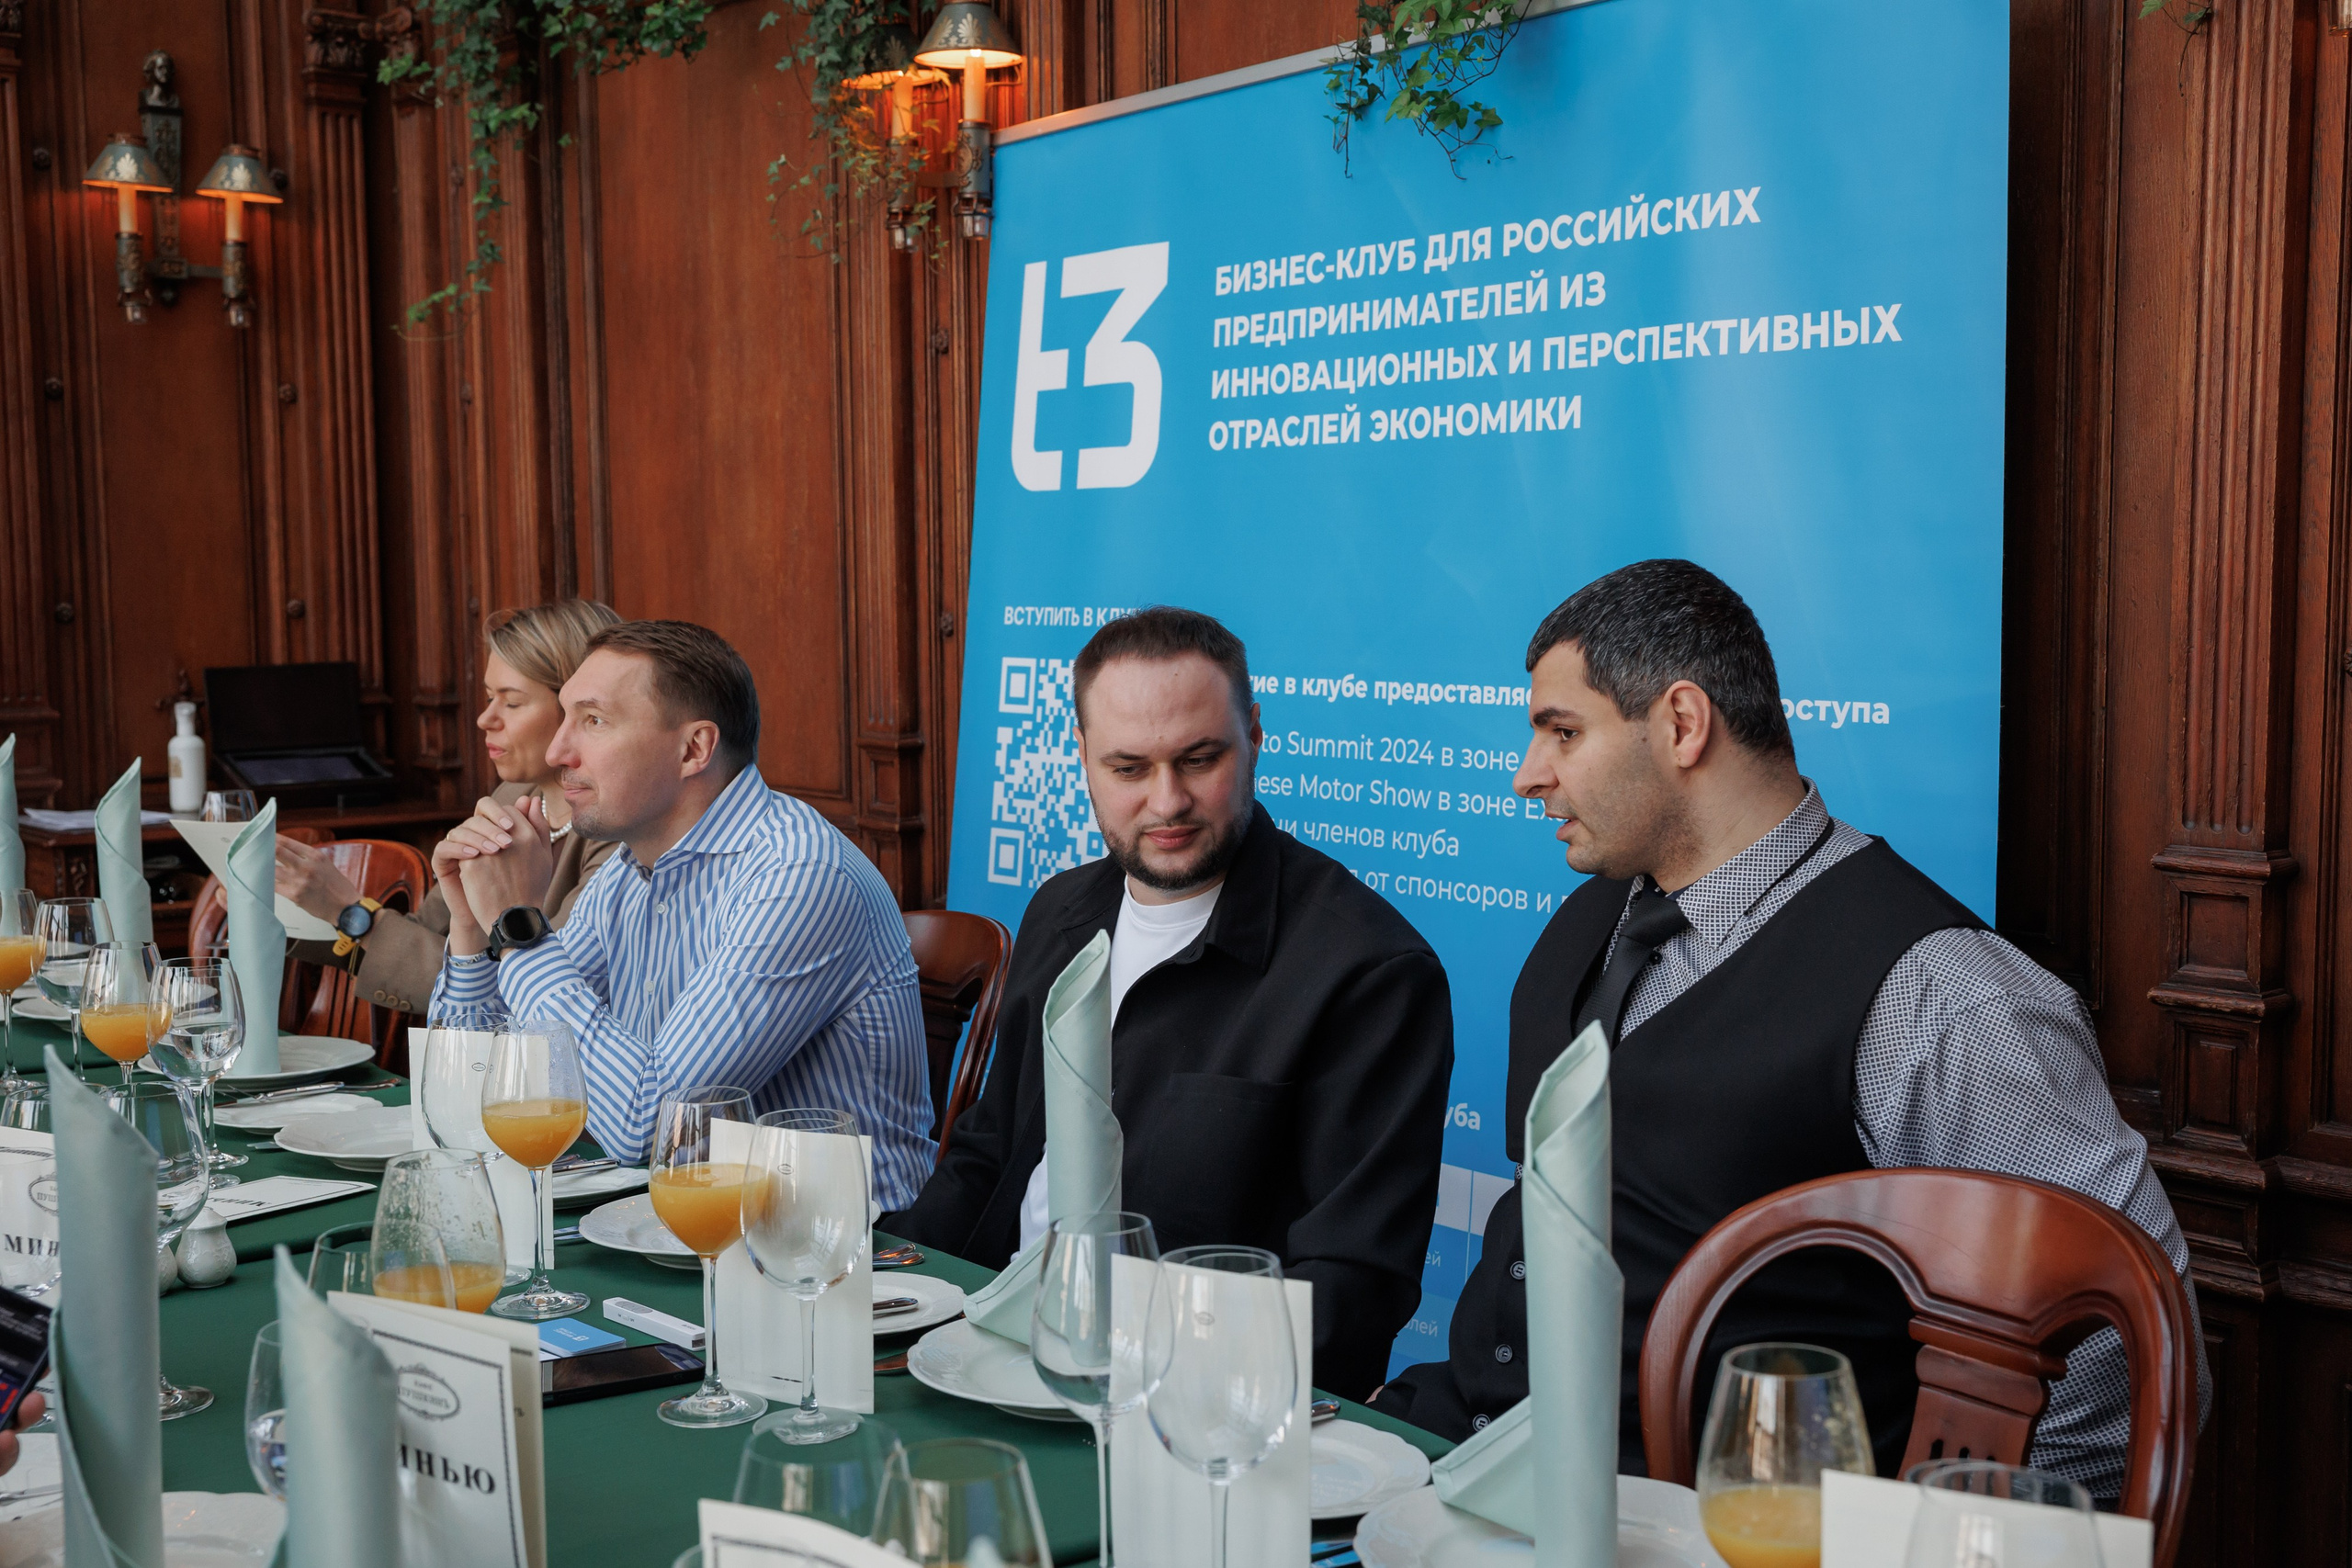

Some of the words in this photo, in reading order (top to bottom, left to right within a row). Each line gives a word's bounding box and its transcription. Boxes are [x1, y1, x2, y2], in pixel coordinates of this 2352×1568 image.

[1216, 238, 1417, 296] БИЗНЕС-КЛУБ
[1424, 226, 1492, 275] ДЛЯ
[1502, 186, 1761, 257] РОССИЙСКИХ
[1214, 269, 1548, 349] ПРЕДПРИНИМАТЕЛЕЙ
[1561, 272, 1606, 310] ИЗ
[1211, 344, 1498, 400] ИННОВАЦИОННЫХ
[1509, 340, 1532, 375] И
[1543, 303, 1905, 371] ПЕРСПЕКТИВНЫХ
[1208, 403, 1361, 451] ОТРАСЛЕЙ
[1369, 395, 1582, 442] ЭКОНОМИКИ
[1003, 605, 1080, 626] ВСТУПИТЬ
[1083, 606, 1093, 626] В
[1284, 676, 1296, 694] в
[1302, 673, 1368, 703] клубе
[1781, 698, 1890, 729] оступа
[1287, 730, 1374, 761] Summit
[1380, 737, 1435, 766] 2024
[1441, 747, 1454, 768] в
[1459, 748, 1520, 773] зоне
[1300, 773, 1364, 804] Motor
[1369, 779, 1431, 810] Show
[1438, 791, 1451, 812] в
[1457, 793, 1517, 818] зоне
[1304, 821, 1385, 848] членов
[1392, 829, 1460, 859] клуба
[1365, 871, 1390, 892] от
[1395, 874, 1528, 910] спонсоров
[1536, 892, 1552, 913] и
[3, 1233, 60, 1258] МИН
